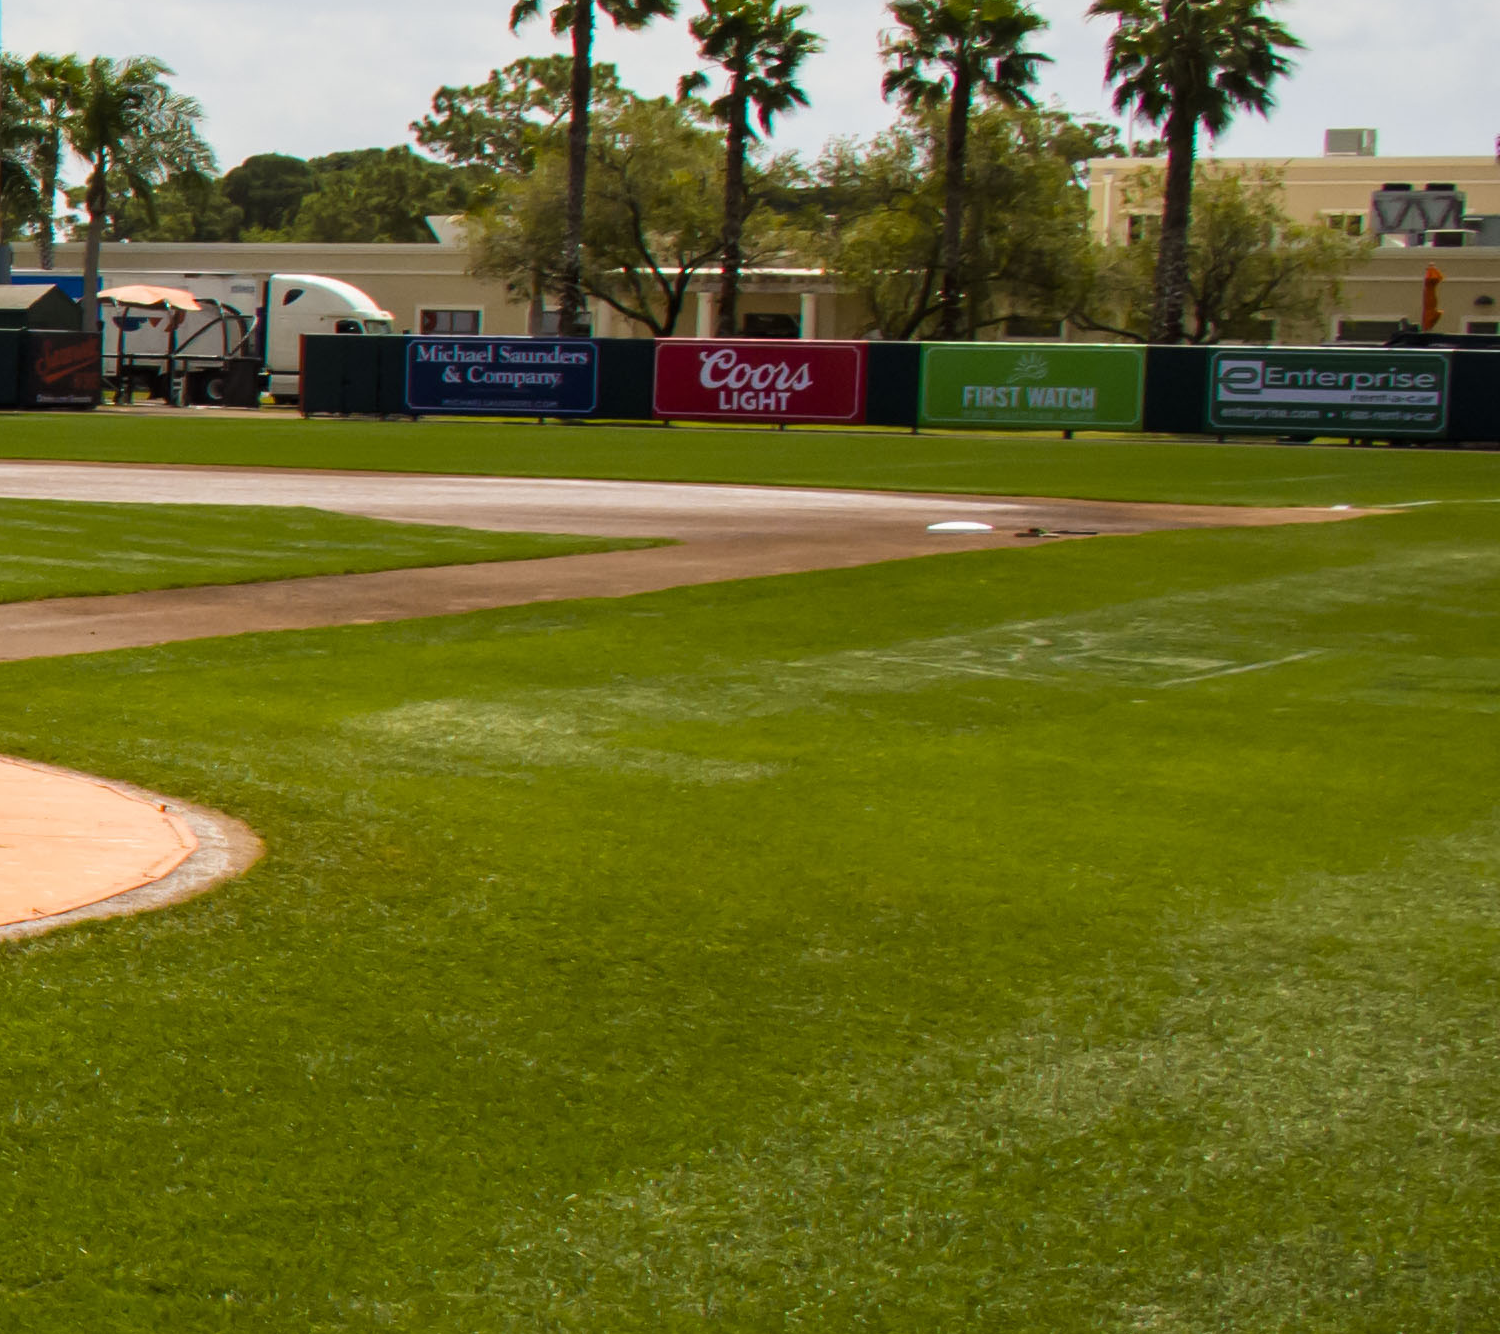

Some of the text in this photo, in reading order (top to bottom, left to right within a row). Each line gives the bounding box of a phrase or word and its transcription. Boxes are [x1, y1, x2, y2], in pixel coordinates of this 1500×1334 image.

[416, 345, 588, 364] Michael Saunders
[442, 366, 562, 388] & Company
[699, 349, 813, 390] Coors
[1265, 367, 1436, 390] Enterprise
[719, 391, 793, 411] LIGHT
[963, 386, 1097, 409] FIRST WATCH
[1351, 393, 1436, 404] rent-a-car
